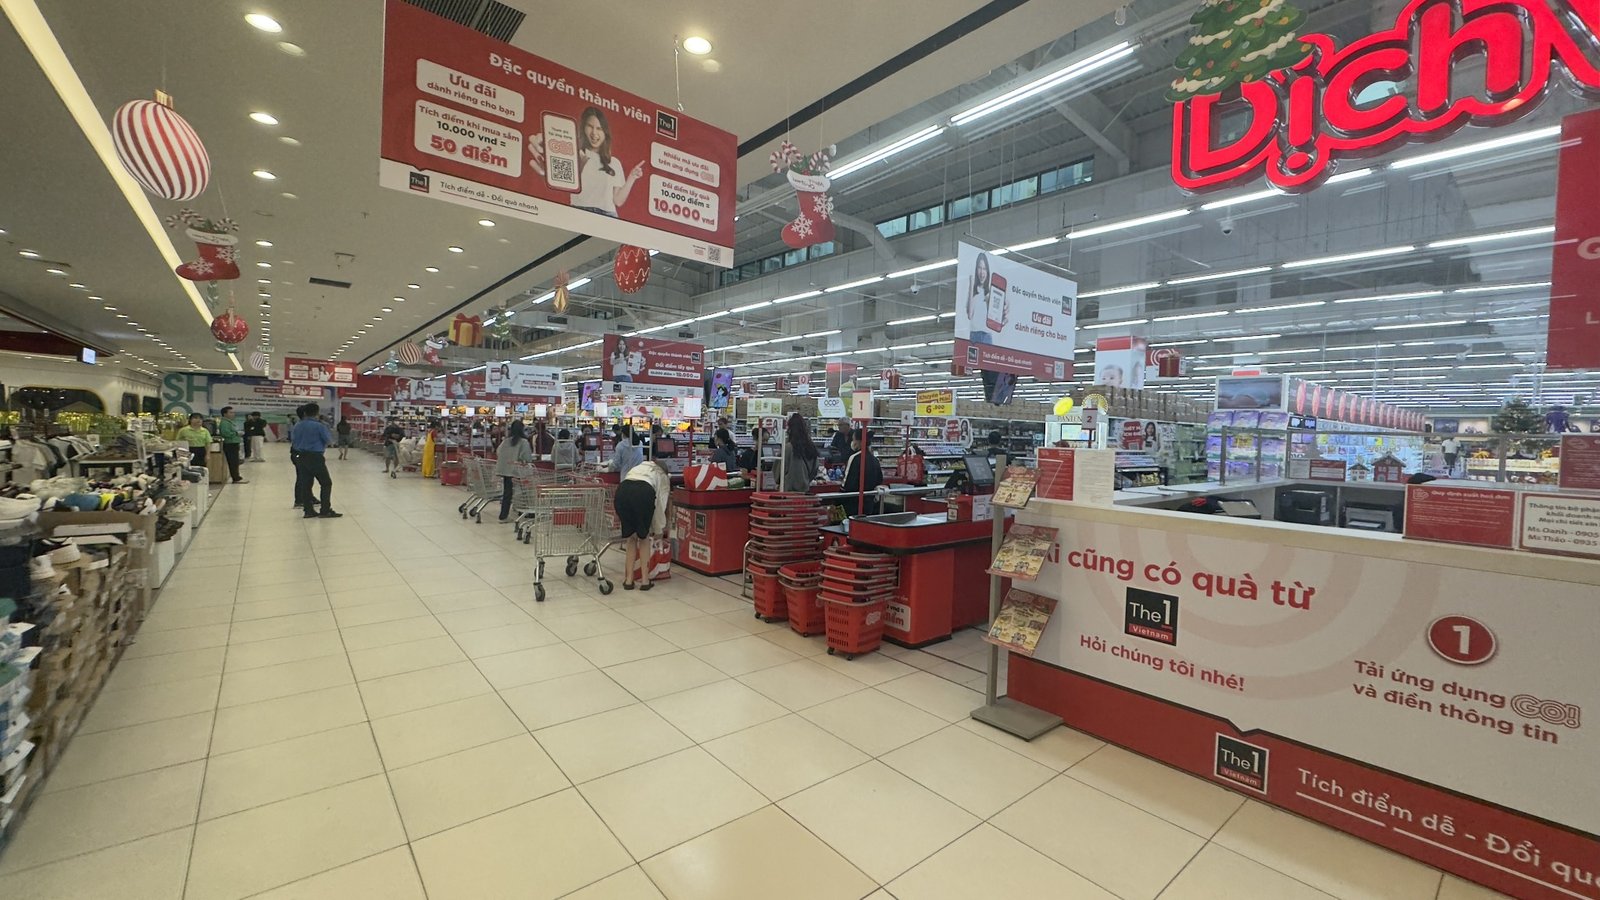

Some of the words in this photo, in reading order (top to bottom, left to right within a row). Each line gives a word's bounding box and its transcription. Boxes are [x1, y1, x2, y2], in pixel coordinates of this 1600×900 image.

[427, 82, 452, 95] dành
[453, 91, 478, 105] riêng
[480, 98, 497, 110] cho
[498, 105, 515, 117] bạn
[449, 73, 470, 90] Ưu
[474, 83, 496, 99] đãi
[489, 52, 522, 75] Đặc
[526, 69, 575, 96] quyền
[579, 87, 620, 113] thành
[622, 104, 651, 124] viên
[419, 105, 439, 118] Tích
[441, 112, 465, 125] điểm
[466, 120, 480, 130] khi
[482, 127, 501, 137] mua
[437, 120, 475, 138] 10.000
[478, 133, 497, 145] vnd
[430, 134, 457, 154] 50
[461, 144, 508, 168] điểm
[440, 181, 456, 191] Tích
[518, 201, 539, 211] nhanh
[661, 189, 686, 202] 10.000
[653, 197, 700, 221] 10.000
[701, 216, 715, 226] vnd
[859, 400, 864, 411] 1
[1087, 415, 1093, 423] 2
[1542, 527, 1568, 535] Oanh
[1067, 548, 1134, 580] cũng
[1144, 561, 1182, 585] có
[1192, 572, 1258, 600] quà
[1271, 579, 1316, 611] từ
[1132, 625, 1169, 641] Vietnam
[1452, 624, 1471, 655] 1
[1079, 634, 1106, 653] Hỏi
[1110, 643, 1164, 671] chúng
[1169, 658, 1195, 678] tôi
[1200, 667, 1245, 692] nhé!
[1354, 660, 1384, 679] Tải
[1391, 667, 1434, 692] ứng
[1441, 681, 1506, 709] dụng
[1510, 693, 1581, 729] GO!
[1353, 682, 1377, 699] và
[1383, 690, 1432, 713] điền
[1440, 702, 1514, 735] thông
[1522, 723, 1559, 745] tin
[1223, 768, 1258, 786] Vietnam
[1298, 767, 1344, 798] Tích
[1351, 789, 1413, 822] điểm
[1421, 814, 1456, 837] dễ
[1484, 832, 1540, 867] Đổi
